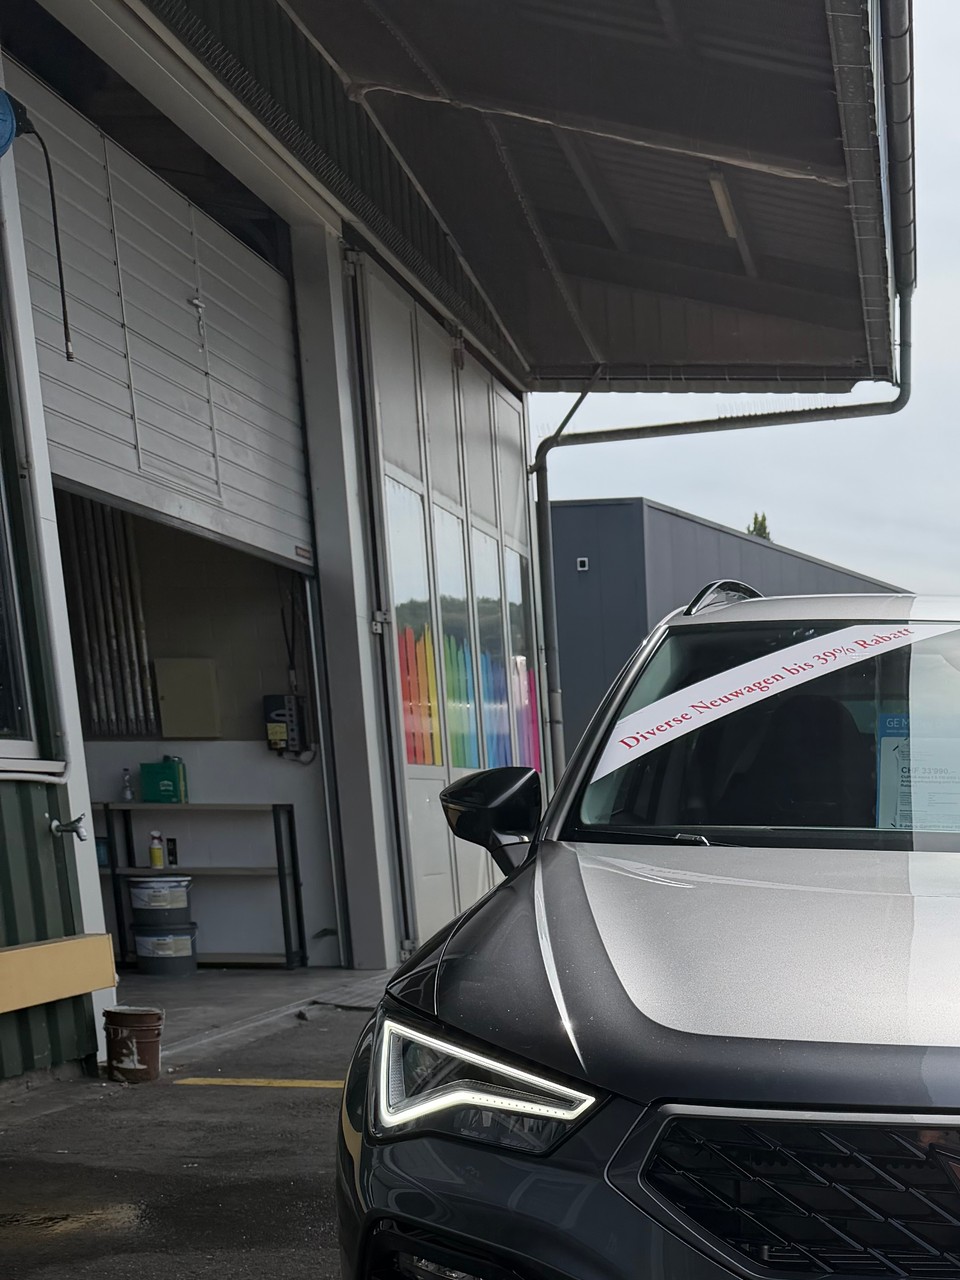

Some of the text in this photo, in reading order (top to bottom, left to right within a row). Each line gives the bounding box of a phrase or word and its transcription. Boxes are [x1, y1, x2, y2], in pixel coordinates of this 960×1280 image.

[619, 628, 914, 750] Diverse Neuwagen bis 39% Rabatt
